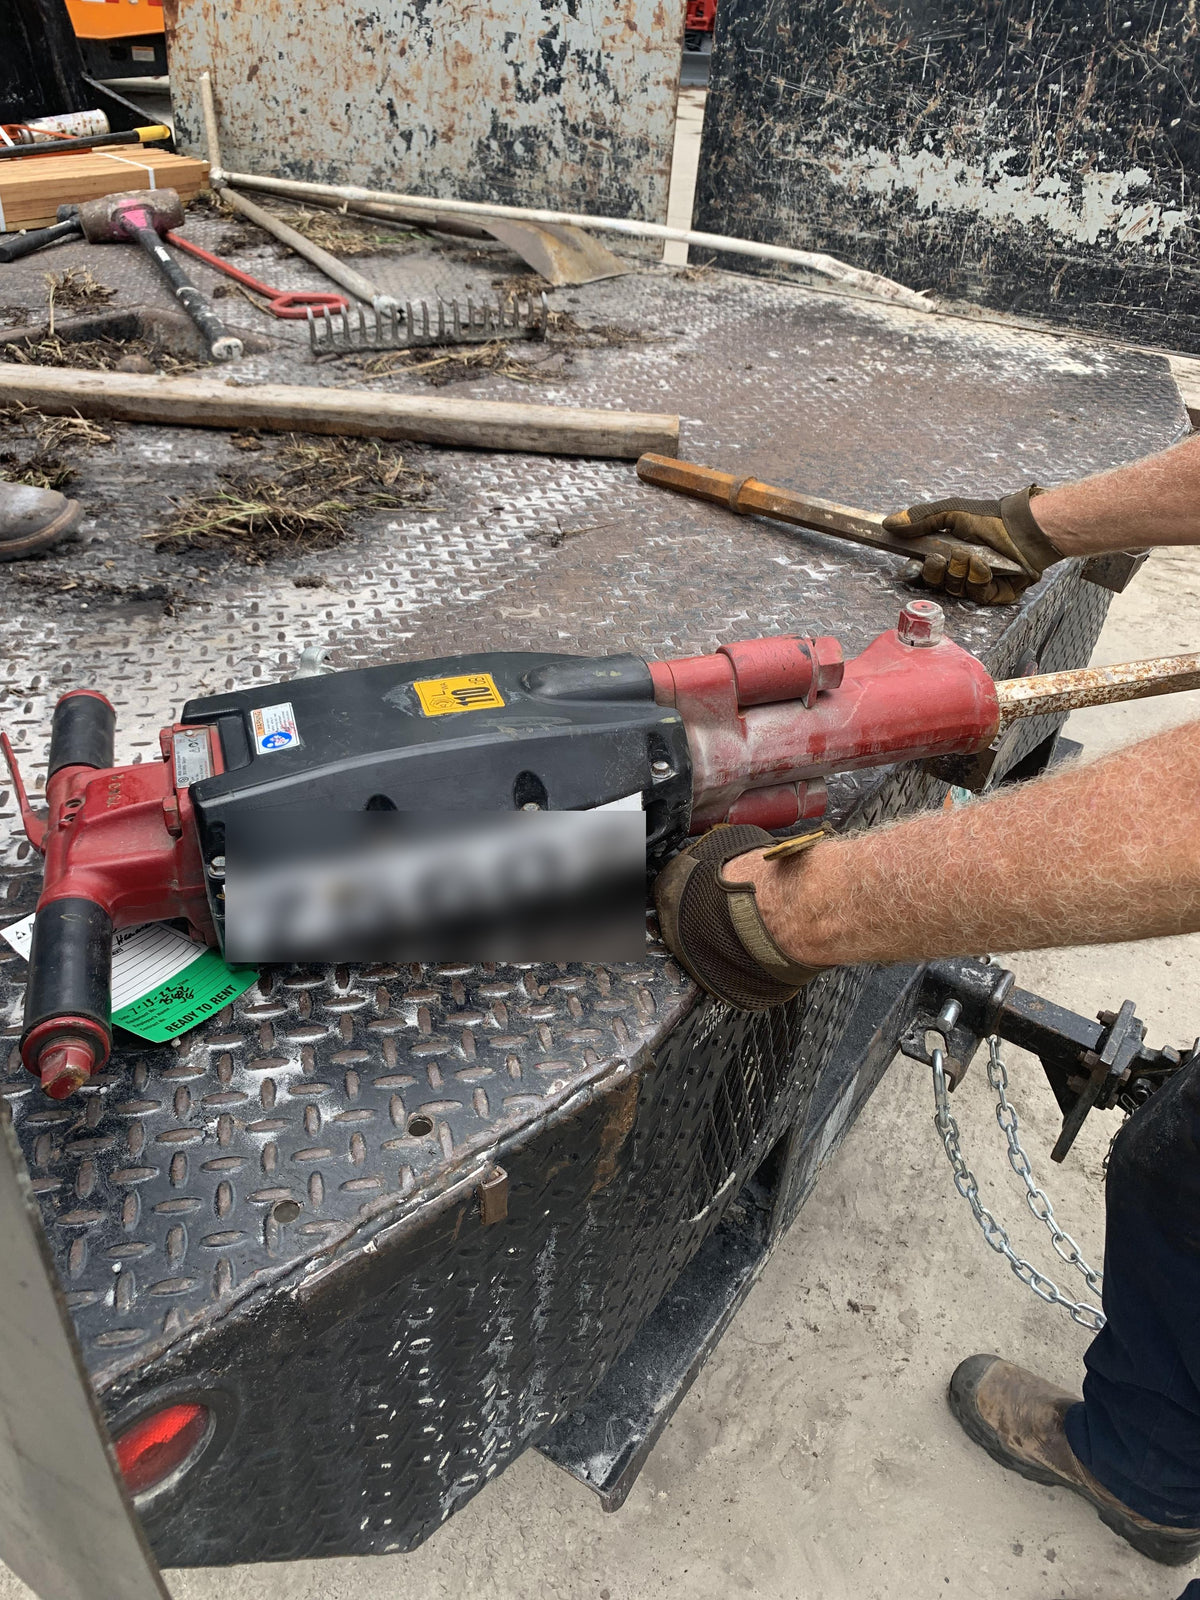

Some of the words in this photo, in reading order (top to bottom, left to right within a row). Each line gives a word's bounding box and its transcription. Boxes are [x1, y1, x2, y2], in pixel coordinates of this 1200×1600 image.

[451, 686, 495, 706] 110
[164, 1010, 199, 1033] READY
[196, 1002, 213, 1014] TO
[210, 984, 238, 1005] RENT
